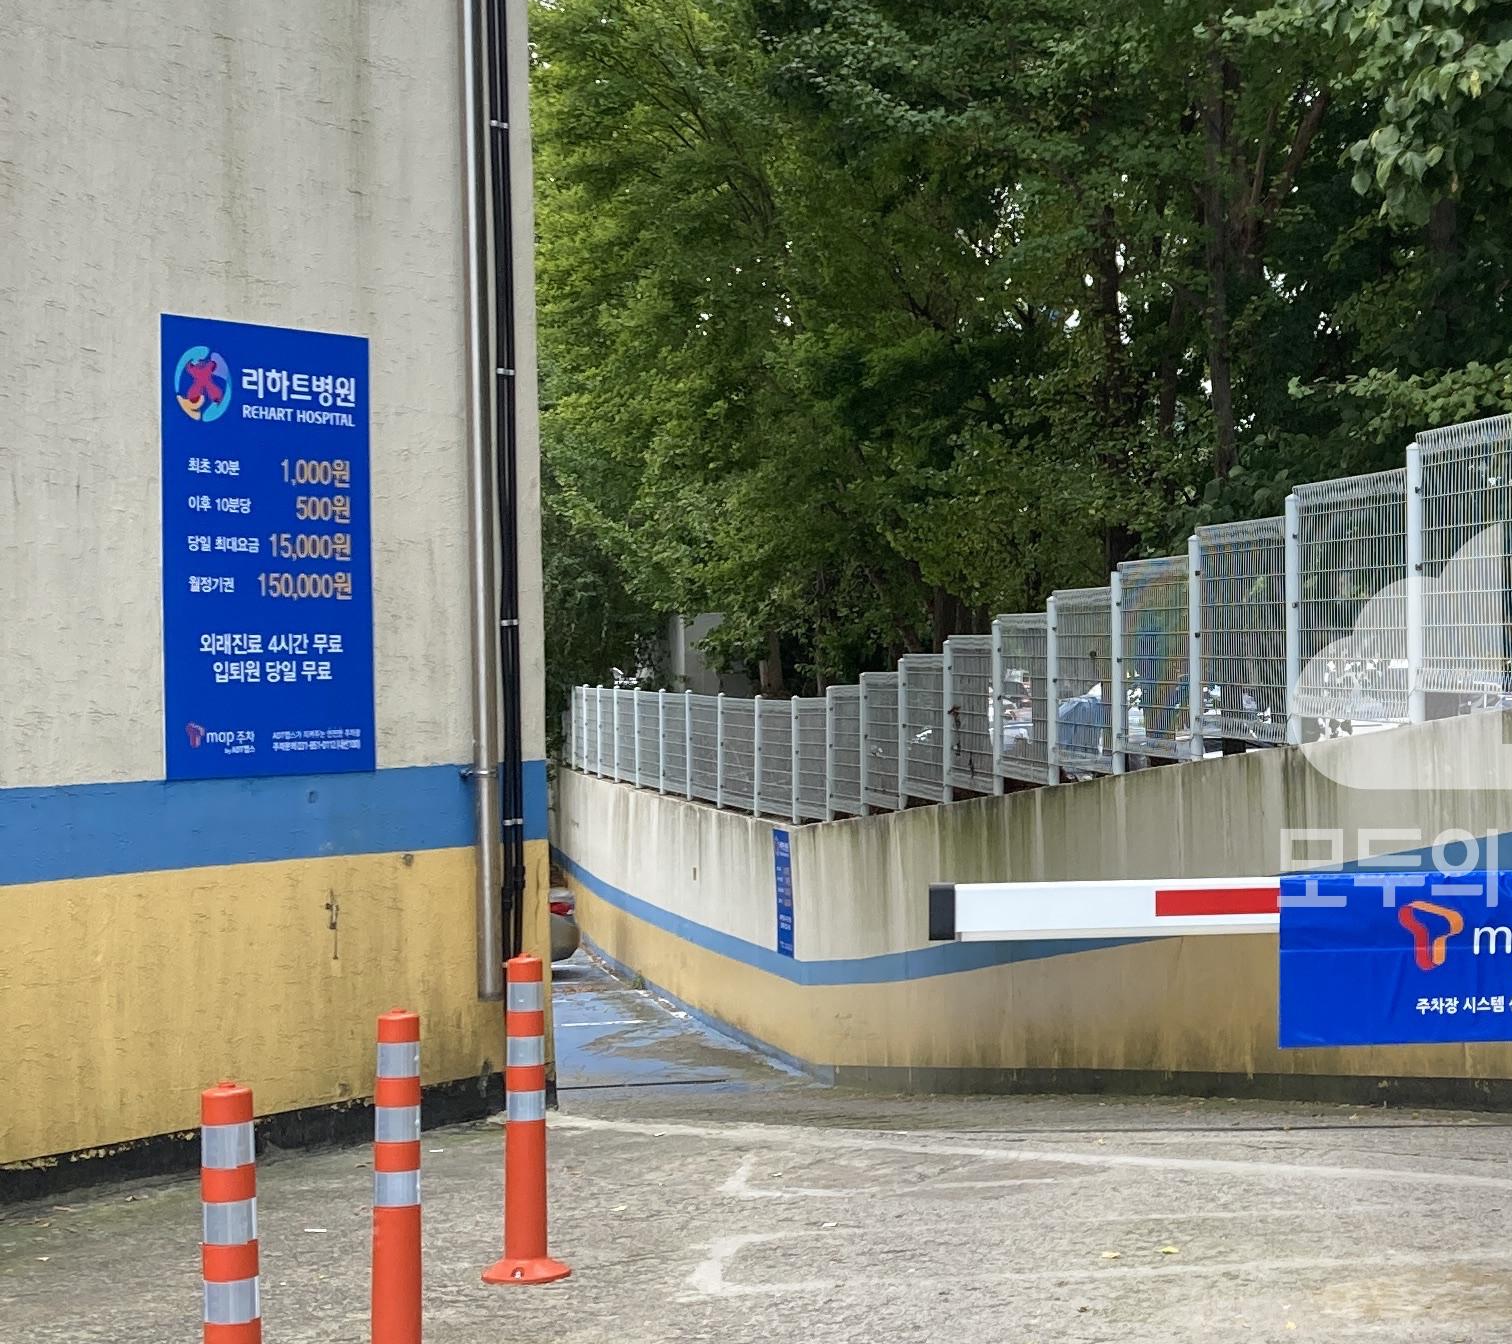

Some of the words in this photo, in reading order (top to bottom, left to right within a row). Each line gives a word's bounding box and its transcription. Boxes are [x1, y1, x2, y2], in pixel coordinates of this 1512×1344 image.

[241, 367, 356, 407] 리하트병원
[242, 404, 294, 422] REHART
[296, 409, 356, 427] HOSPITAL
[188, 457, 211, 474] 최초
[214, 460, 240, 476] 30분
[281, 458, 350, 488] 1,000원
[188, 495, 211, 512] 이후
[215, 497, 251, 514] 10분당
[296, 495, 350, 524] 500원
[187, 535, 211, 552] 당일
[214, 536, 260, 553] 최대요금
[269, 533, 351, 561] 15,000원
[189, 575, 235, 593] 월정기권
[257, 571, 352, 600] 150,000원
[199, 633, 264, 655] 외래진료
[267, 633, 309, 655] 4시간
[312, 633, 344, 655] 무료
[213, 660, 260, 683] 입퇴원
[265, 660, 297, 683] 당일
[301, 661, 333, 682] 무료
[236, 730, 255, 744] 주차
[1416, 997, 1459, 1015] 주차장
[1463, 996, 1505, 1013] 시스템
